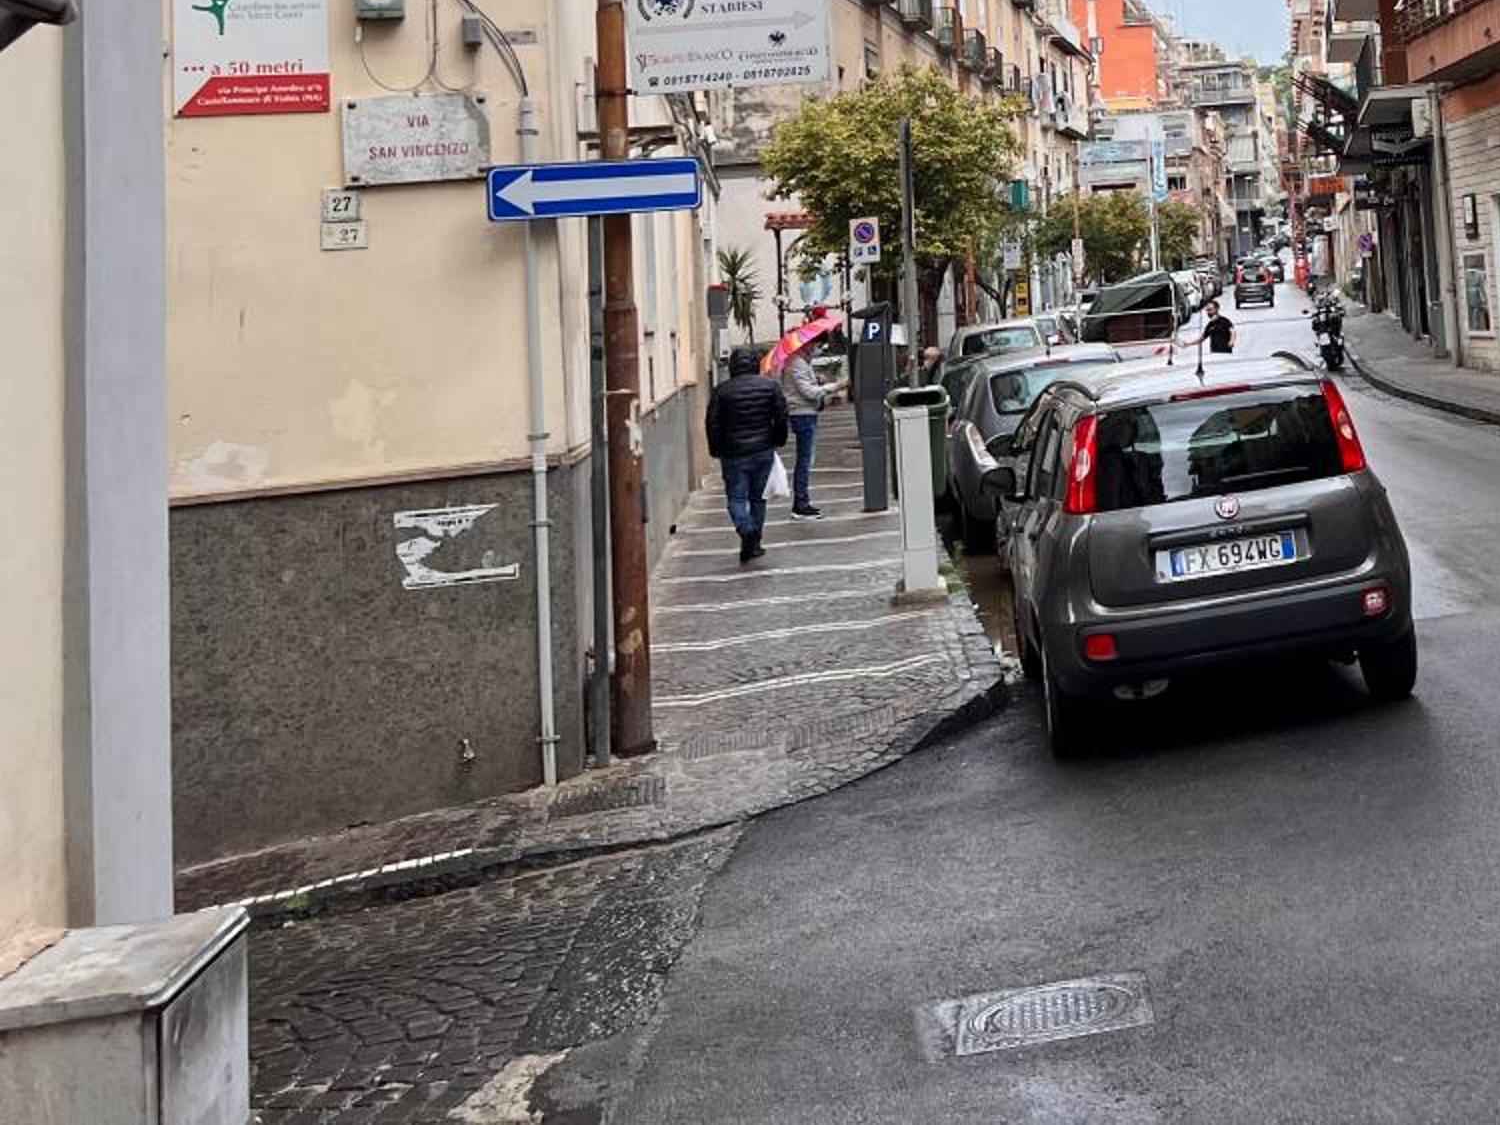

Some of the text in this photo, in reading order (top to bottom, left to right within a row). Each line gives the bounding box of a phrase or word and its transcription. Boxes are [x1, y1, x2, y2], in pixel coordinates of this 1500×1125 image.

[700, 0, 764, 14] STABIESI
[211, 64, 221, 75] a
[228, 61, 250, 75] 50
[255, 58, 304, 74] metri
[407, 114, 430, 128] VIA
[368, 142, 469, 161] SAN VINCENZO
[332, 196, 351, 213] 27
[338, 228, 359, 243] 27
[867, 322, 881, 340] P
[1185, 537, 1281, 573] FX 694WG
